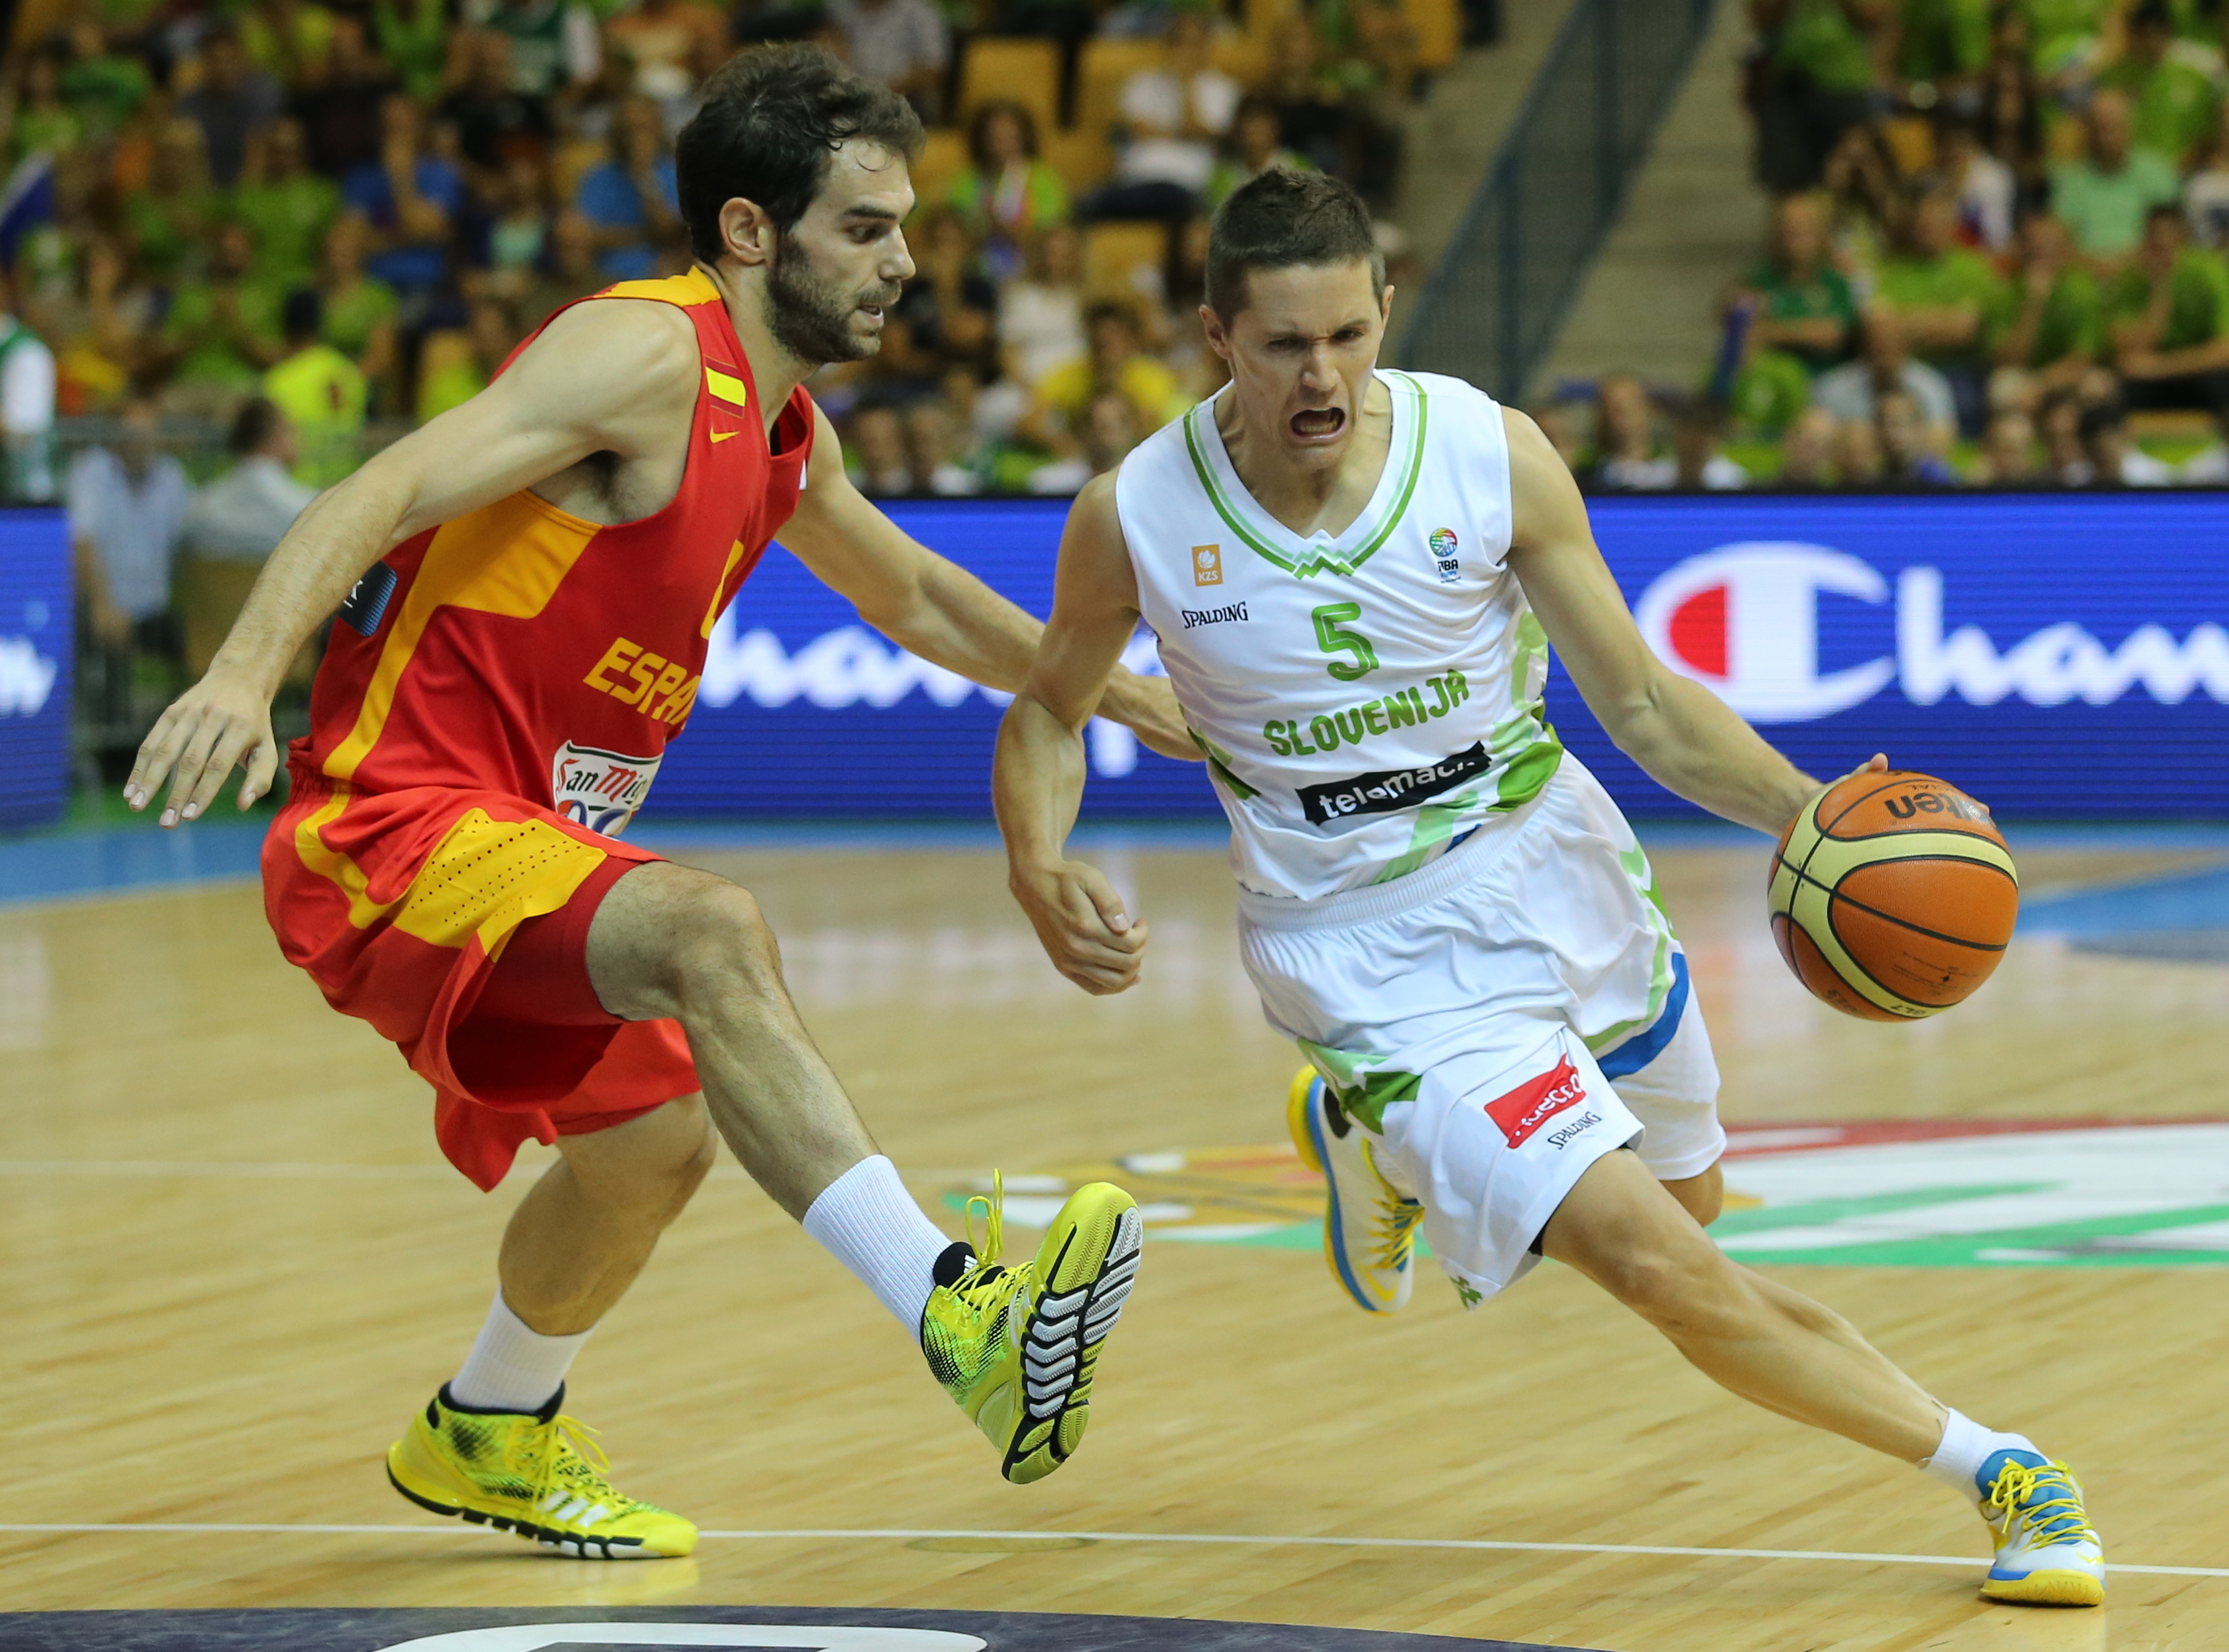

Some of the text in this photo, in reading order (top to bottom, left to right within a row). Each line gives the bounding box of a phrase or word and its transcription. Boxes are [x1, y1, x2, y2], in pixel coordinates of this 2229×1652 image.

[1198, 570, 1219, 582] KZS
[1182, 601, 1249, 629] SPALDING
[1311, 602, 1379, 681] 5
[1263, 669, 1470, 756] SLOVENIJA
[1547, 1111, 1602, 1151] SPALDING
